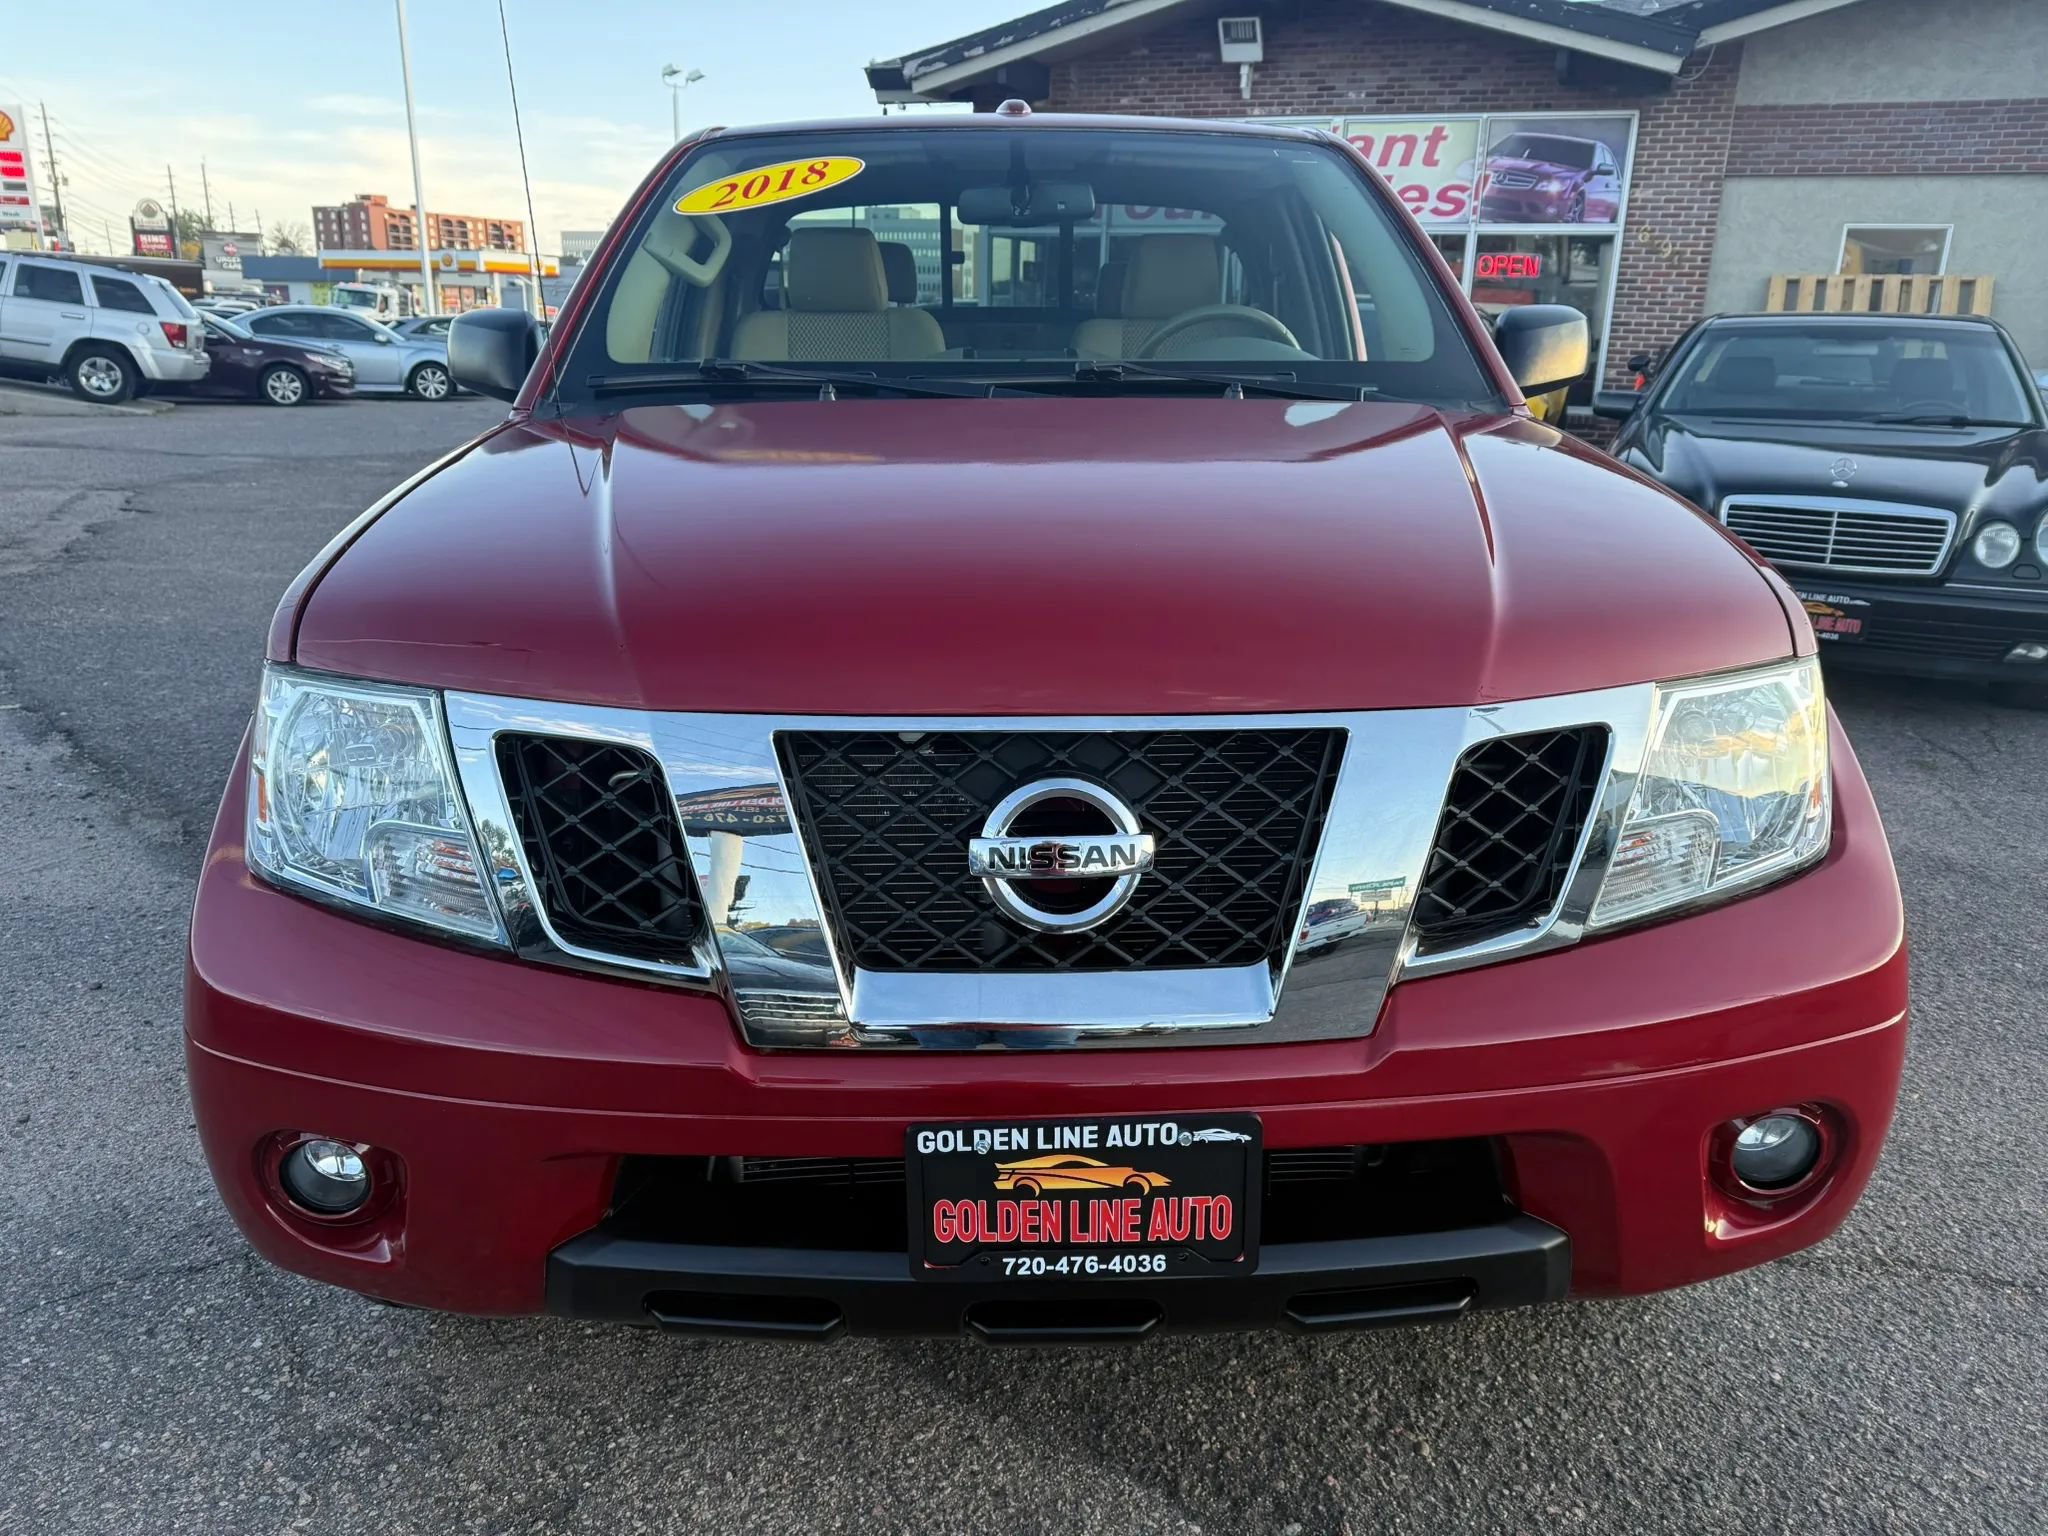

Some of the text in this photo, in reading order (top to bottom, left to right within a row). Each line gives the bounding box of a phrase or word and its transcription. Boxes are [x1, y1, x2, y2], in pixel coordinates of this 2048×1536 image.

[1332, 125, 1449, 167] ant
[710, 160, 830, 209] 2018
[1384, 174, 1491, 217] es!
[1478, 254, 1539, 278] OPEN
[1828, 595, 1850, 604] AUTO
[988, 843, 1136, 871] NISSAN
[917, 1122, 1178, 1154] GOLDEN LINE AUTO
[933, 1194, 1233, 1243] GOLDEN LINE AUTO
[1003, 1254, 1166, 1276] 720-476-4036
